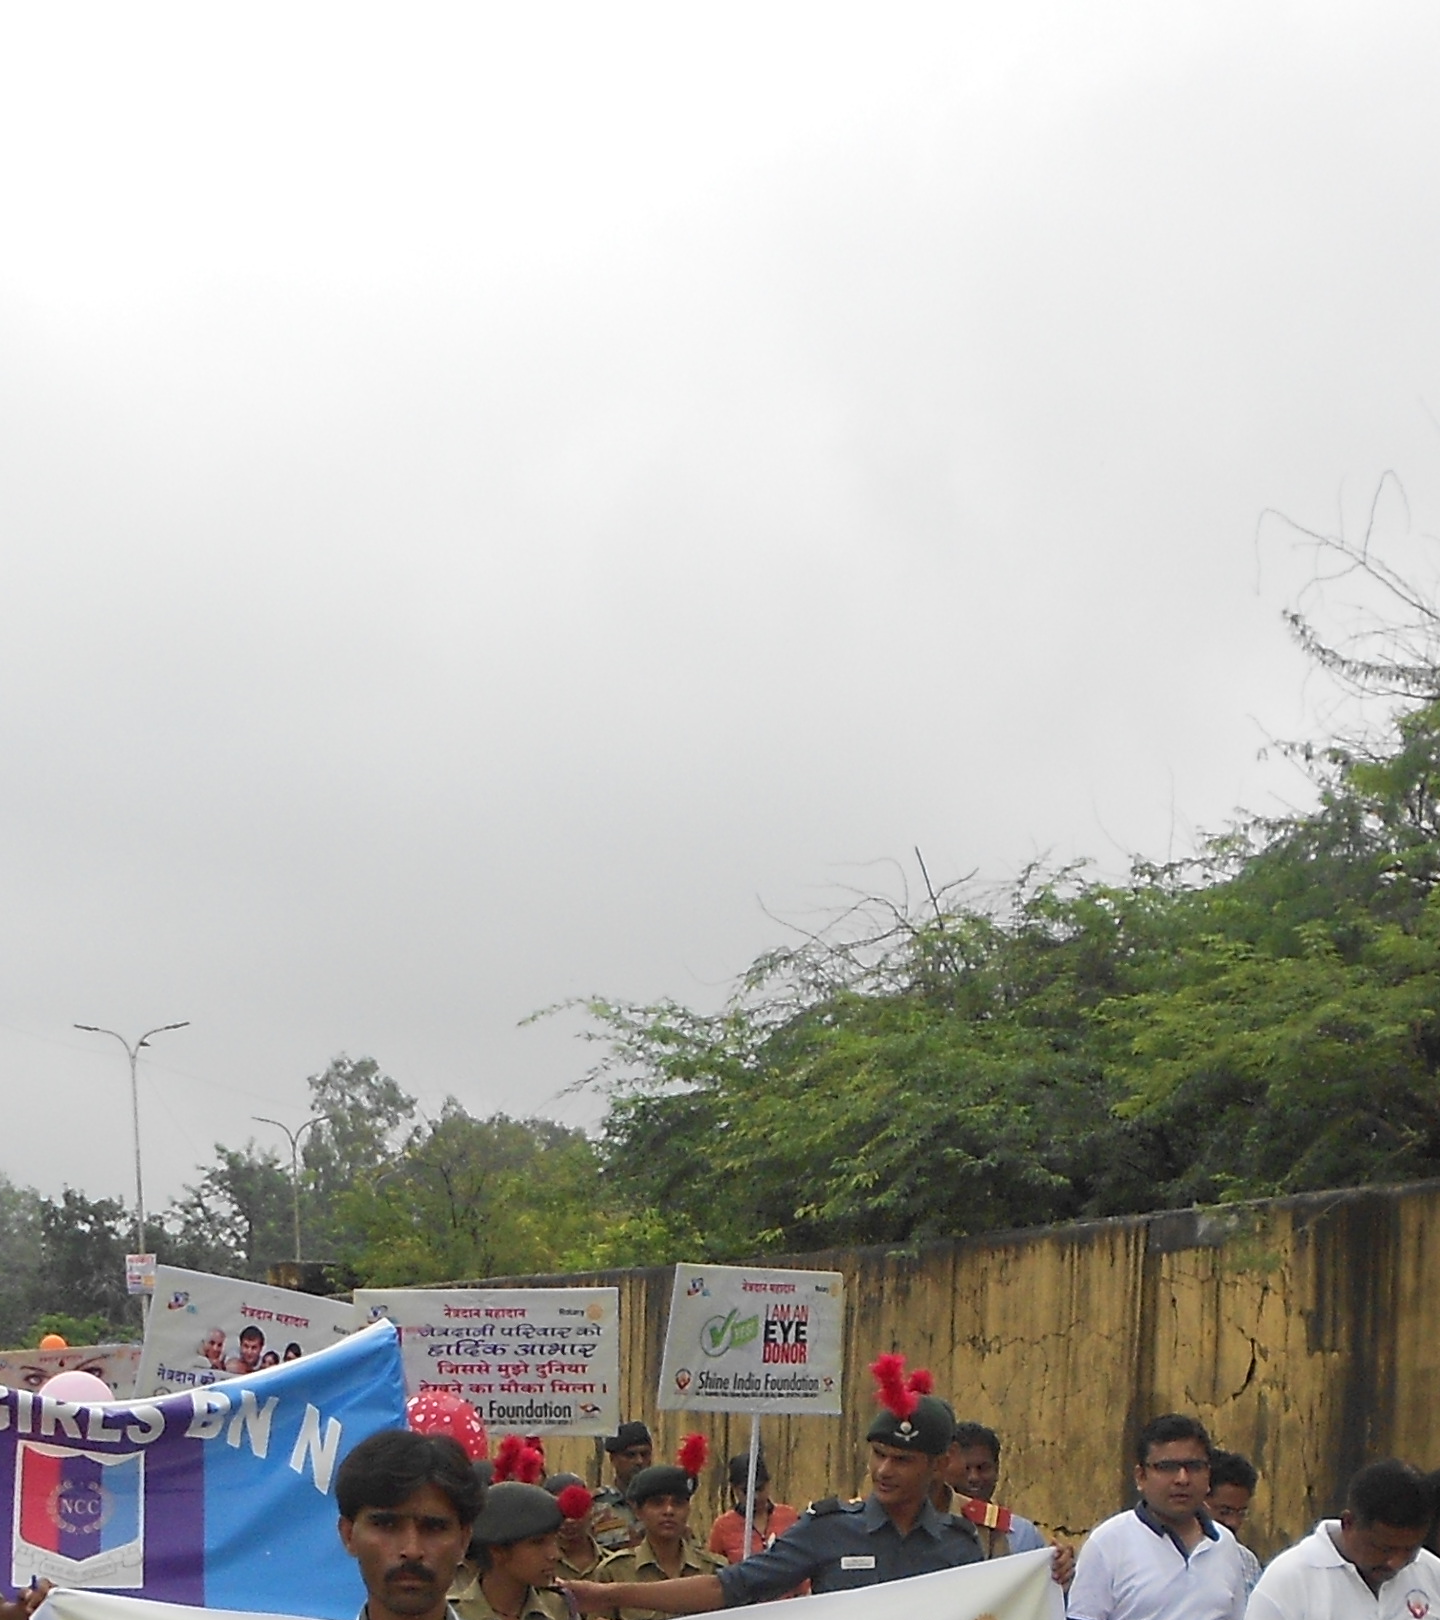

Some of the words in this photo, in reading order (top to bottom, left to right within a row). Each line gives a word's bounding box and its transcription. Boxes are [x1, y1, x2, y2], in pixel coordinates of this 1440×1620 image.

[241, 1303, 273, 1322] नेत्रदान
[443, 1304, 481, 1319] नेत्रदान
[485, 1307, 527, 1319] महादान
[772, 1304, 791, 1321] AM
[793, 1304, 809, 1321] AN
[501, 1324, 572, 1339] परिवार
[575, 1323, 601, 1337] को
[763, 1320, 808, 1343] EYE
[427, 1339, 510, 1358] हार्दिक
[513, 1341, 598, 1358] आभार
[762, 1342, 807, 1364] DONOR
[157, 1363, 196, 1387] नेत्रदान
[437, 1360, 491, 1375] जिससे
[497, 1360, 530, 1379] मुझे
[536, 1360, 589, 1379] दुनिया
[468, 1383, 494, 1394] का
[499, 1380, 546, 1394] मौका
[698, 1370, 730, 1390] Shine
[733, 1372, 760, 1391] India
[763, 1371, 819, 1392] Foundation
[488, 1398, 572, 1418] Foundation
[185, 1389, 279, 1459] BN
[60, 1496, 101, 1516] NCC
